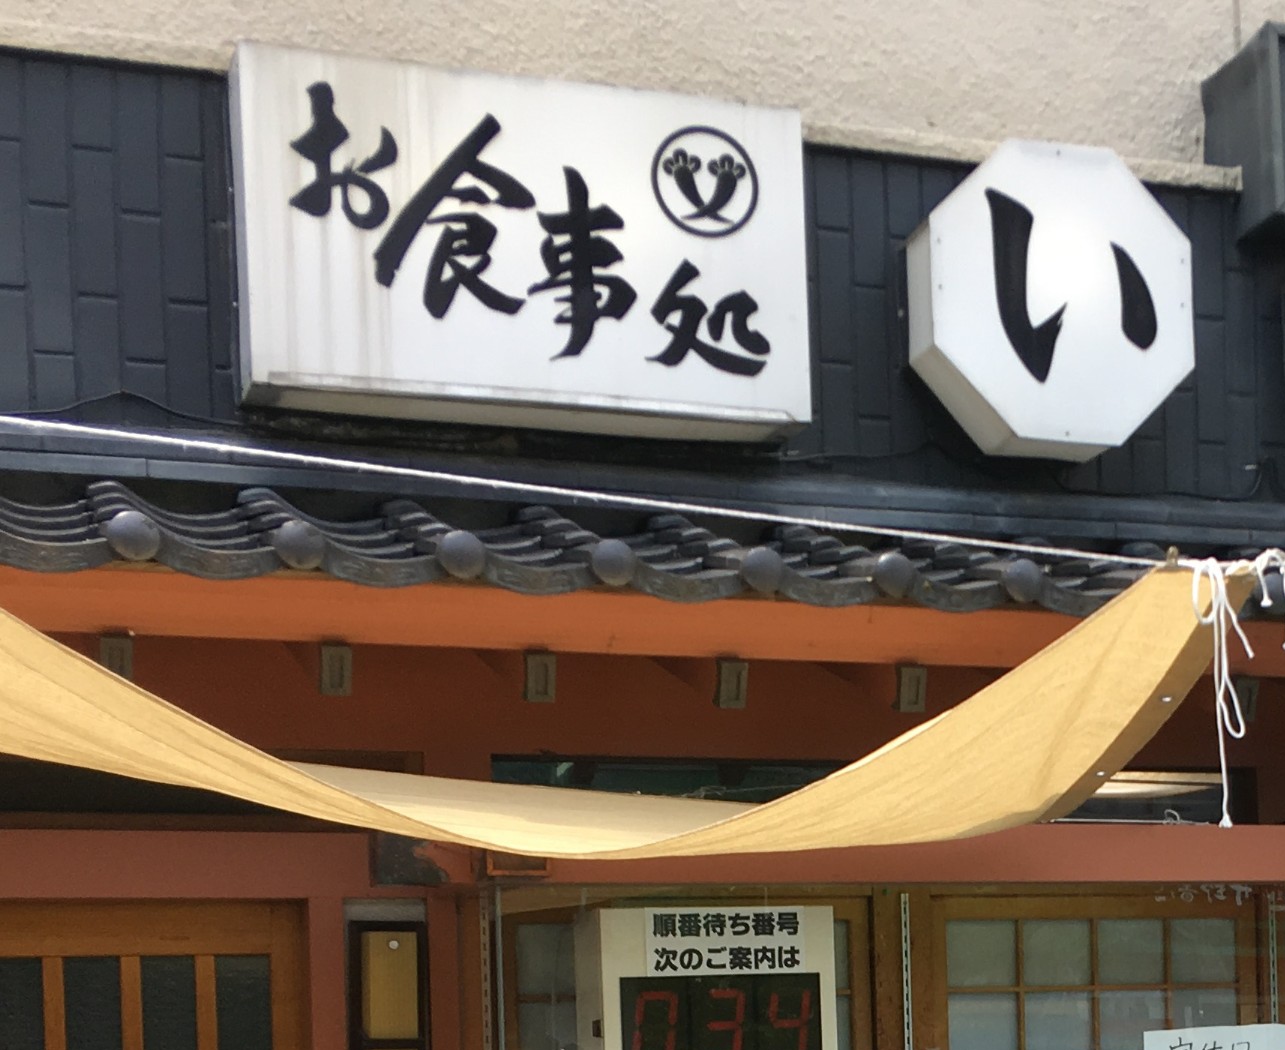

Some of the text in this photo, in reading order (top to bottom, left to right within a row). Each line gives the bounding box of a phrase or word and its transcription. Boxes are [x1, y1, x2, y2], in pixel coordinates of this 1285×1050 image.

[289, 80, 773, 378] お食事処
[652, 911, 801, 938] 順番待ち番号
[653, 946, 801, 972] 次のご案内は
